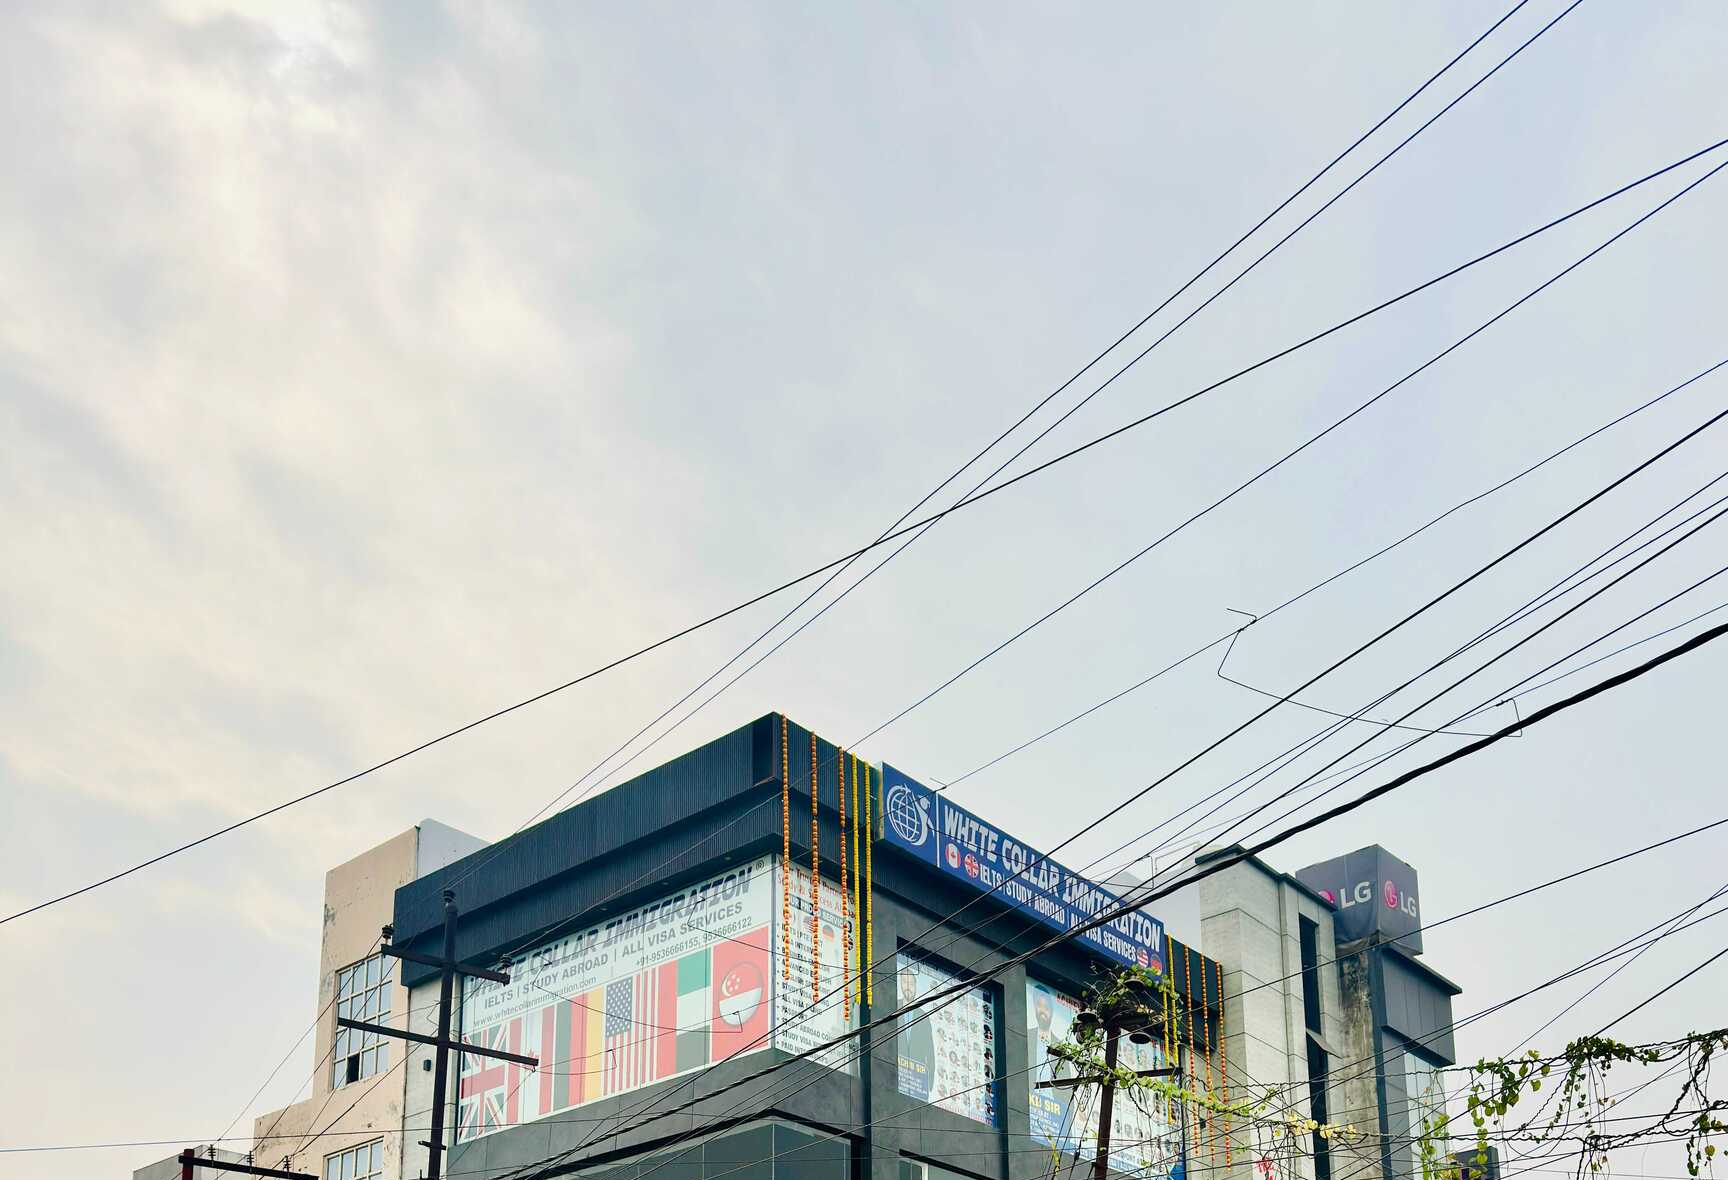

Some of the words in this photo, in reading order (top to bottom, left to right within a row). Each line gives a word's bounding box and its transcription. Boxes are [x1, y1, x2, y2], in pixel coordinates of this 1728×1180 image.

[944, 805, 999, 863] WHITE
[1002, 839, 1059, 898] COLLAR
[1340, 881, 1372, 909] LG
[602, 866, 753, 948] IMMIGRATION
[980, 864, 1002, 890] IELTS
[1006, 879, 1032, 907] STUDY
[1034, 894, 1065, 924] ABROAD
[1103, 930, 1136, 962] SERVICES
[1400, 891, 1417, 918] LG
[485, 989, 513, 1009] IELTS
[523, 972, 559, 994] STUDY
[562, 954, 609, 979] ABROAD
[622, 940, 644, 957] ALL
[648, 928, 677, 946] VISA
[680, 902, 743, 932] SERVICES
